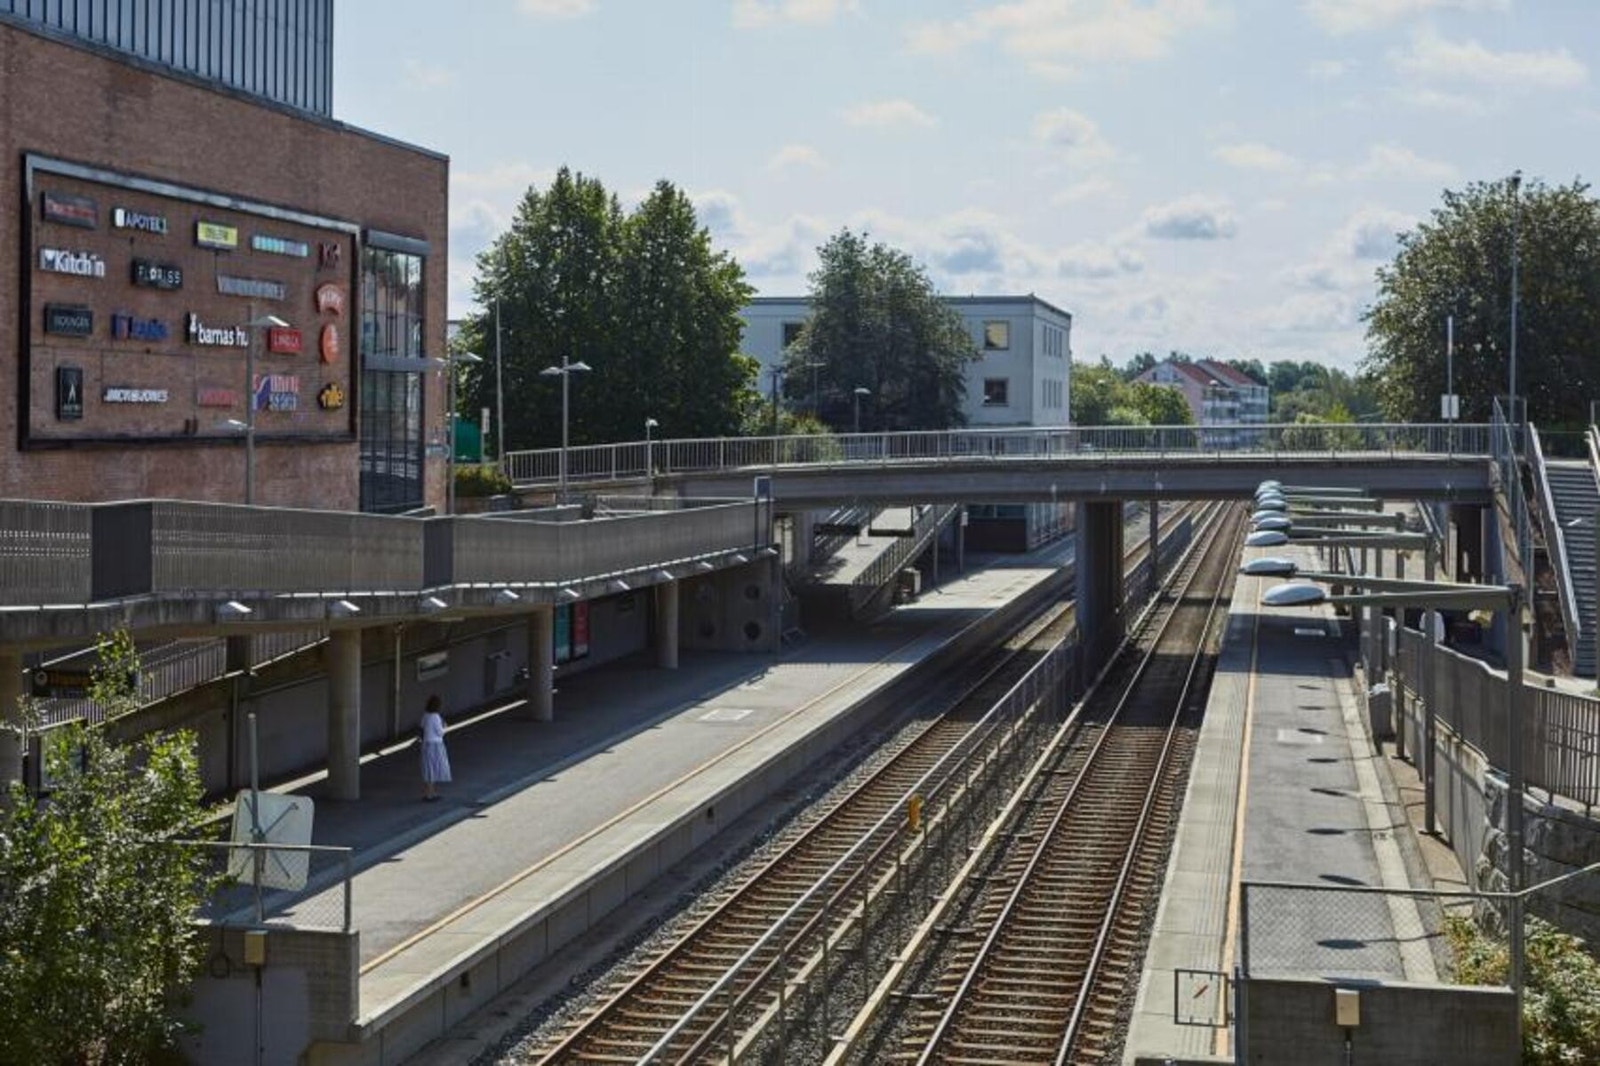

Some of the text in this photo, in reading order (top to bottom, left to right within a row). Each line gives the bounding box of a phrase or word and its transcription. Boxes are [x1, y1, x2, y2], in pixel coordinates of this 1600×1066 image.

[125, 212, 162, 232] APOTEK
[198, 322, 249, 348] barnas hu
